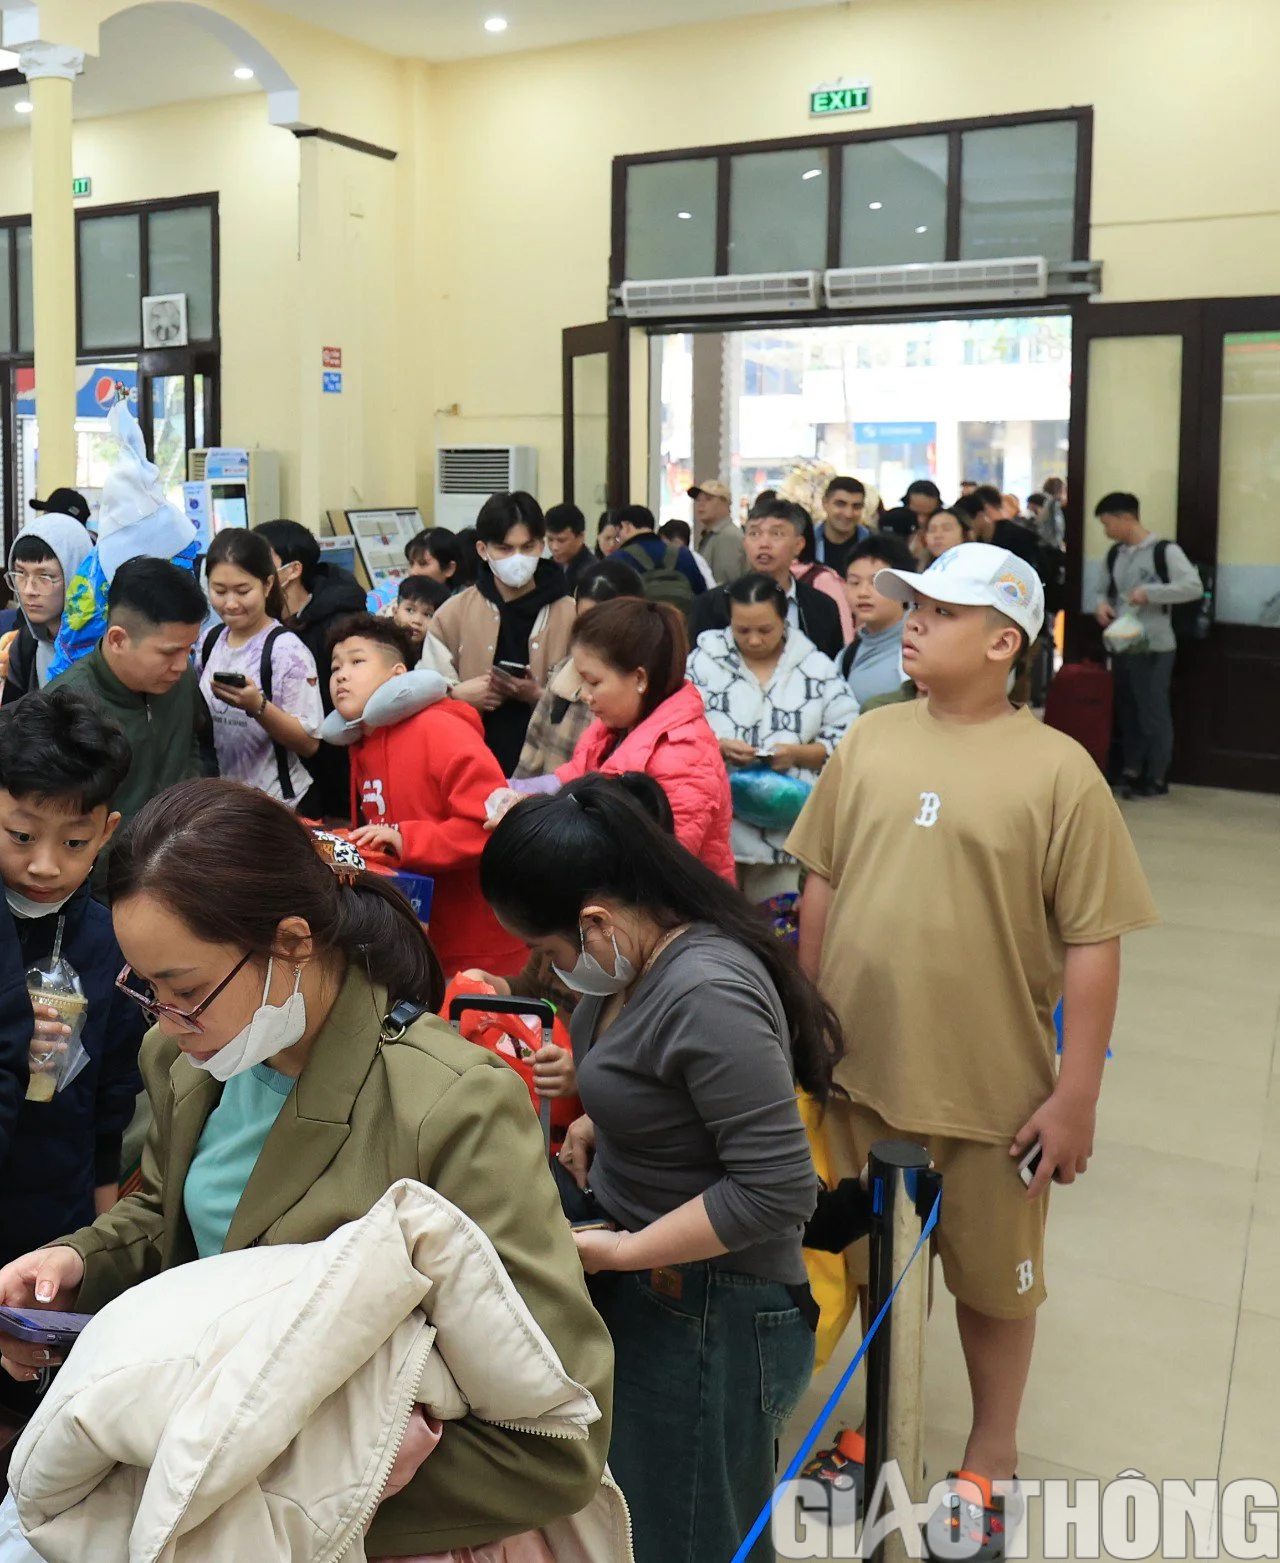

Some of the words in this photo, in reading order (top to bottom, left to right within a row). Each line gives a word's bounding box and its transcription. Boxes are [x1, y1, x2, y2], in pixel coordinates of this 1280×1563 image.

[813, 88, 867, 112] EXIT
[912, 791, 941, 828] B
[1015, 1259, 1034, 1295] B
